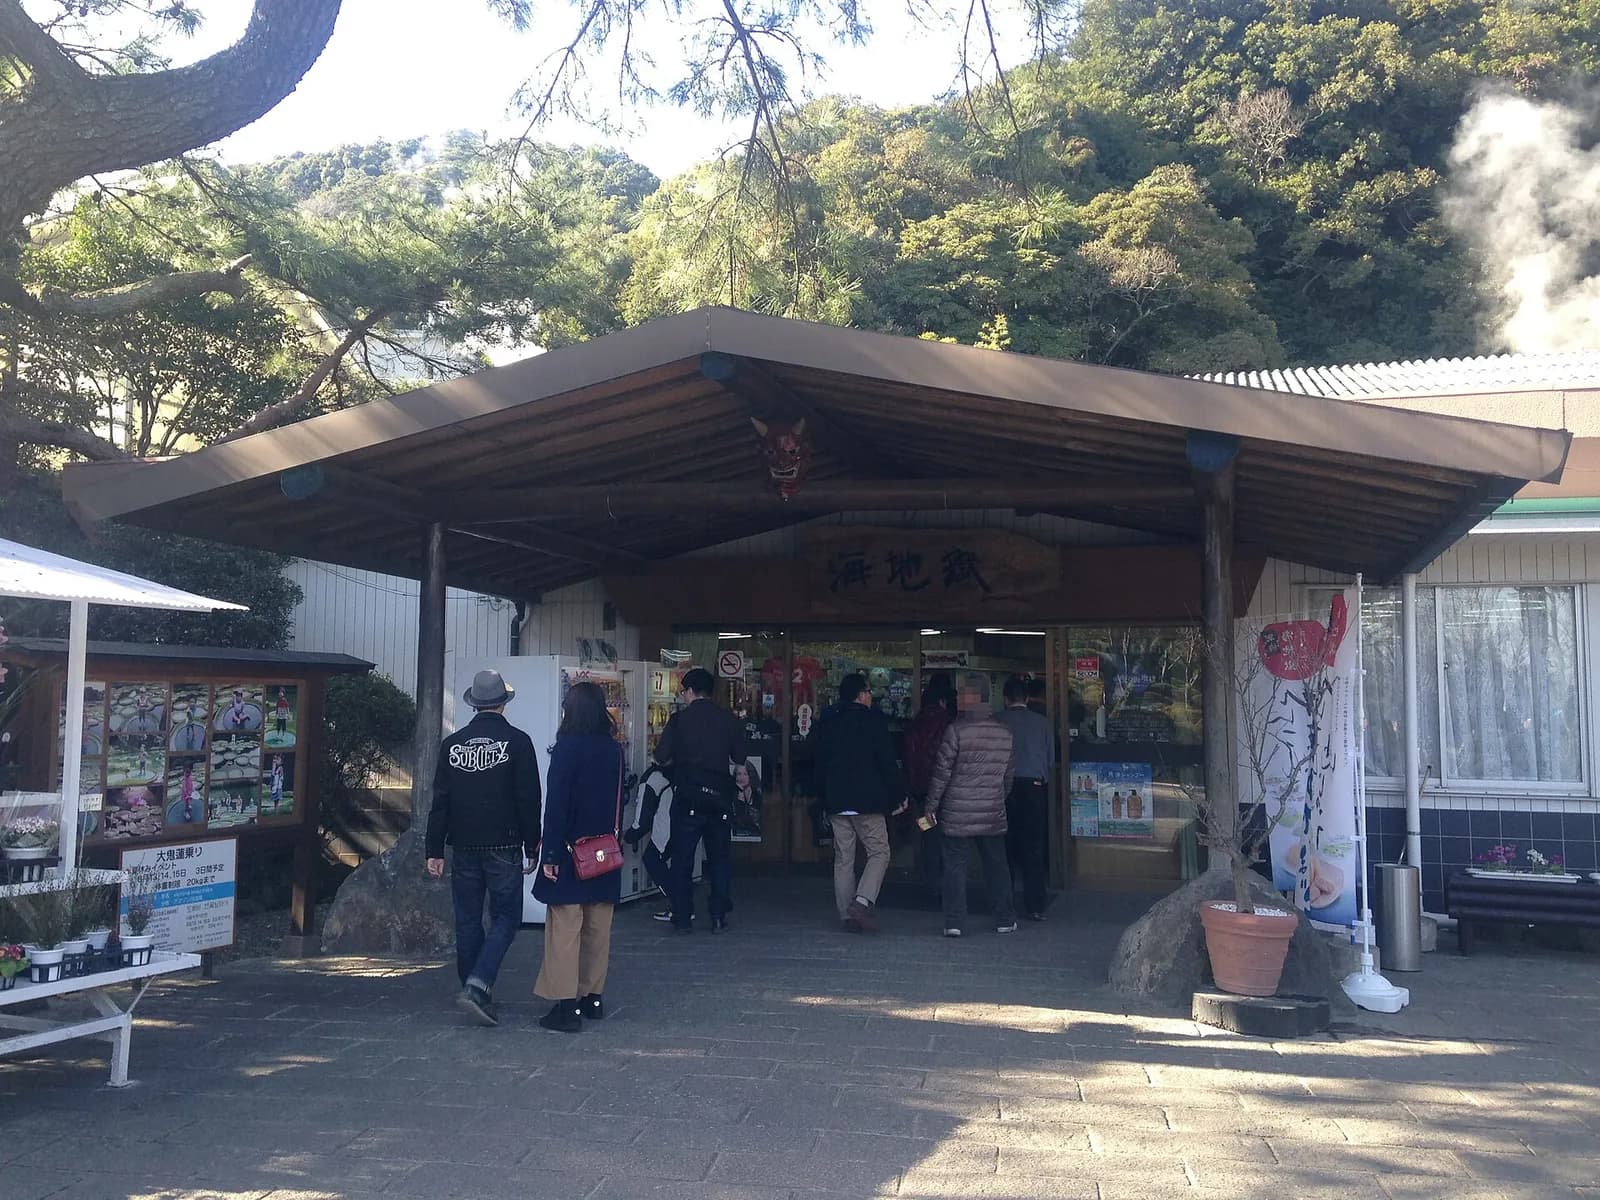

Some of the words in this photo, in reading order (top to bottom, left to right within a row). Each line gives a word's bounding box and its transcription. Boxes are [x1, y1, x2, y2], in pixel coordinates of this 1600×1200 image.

[156, 846, 203, 863] 大鬼蓮乗り
